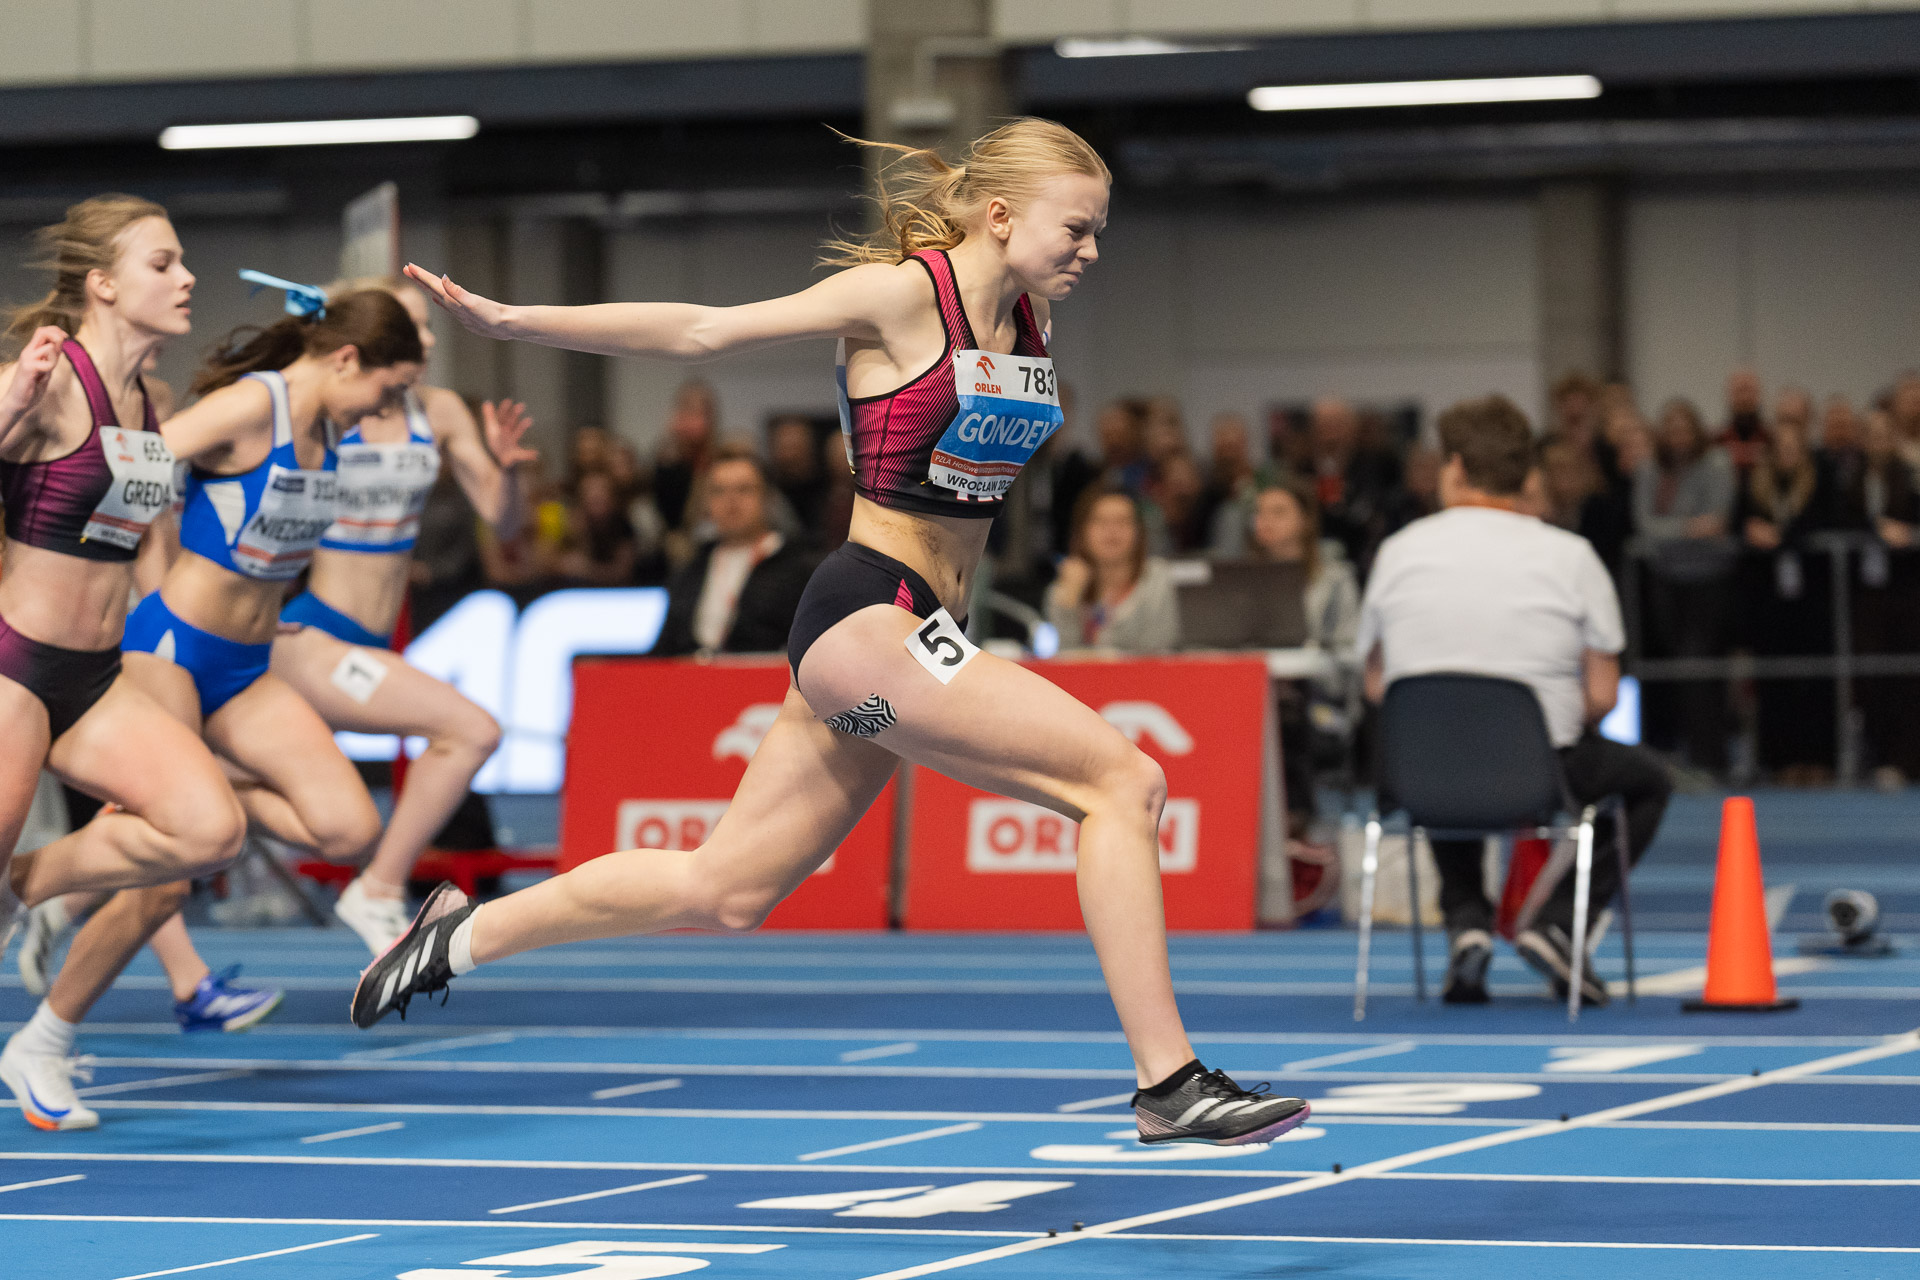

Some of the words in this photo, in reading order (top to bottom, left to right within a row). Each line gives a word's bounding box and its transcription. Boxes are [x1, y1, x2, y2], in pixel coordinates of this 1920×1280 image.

[974, 382, 1002, 395] ORLEN
[1018, 366, 1054, 397] 783
[934, 454, 951, 466] PZLA
[946, 473, 998, 492] WROCŁAW
[918, 618, 965, 667] 5
[735, 1180, 1078, 1218] 4
[396, 1240, 788, 1280] 5
